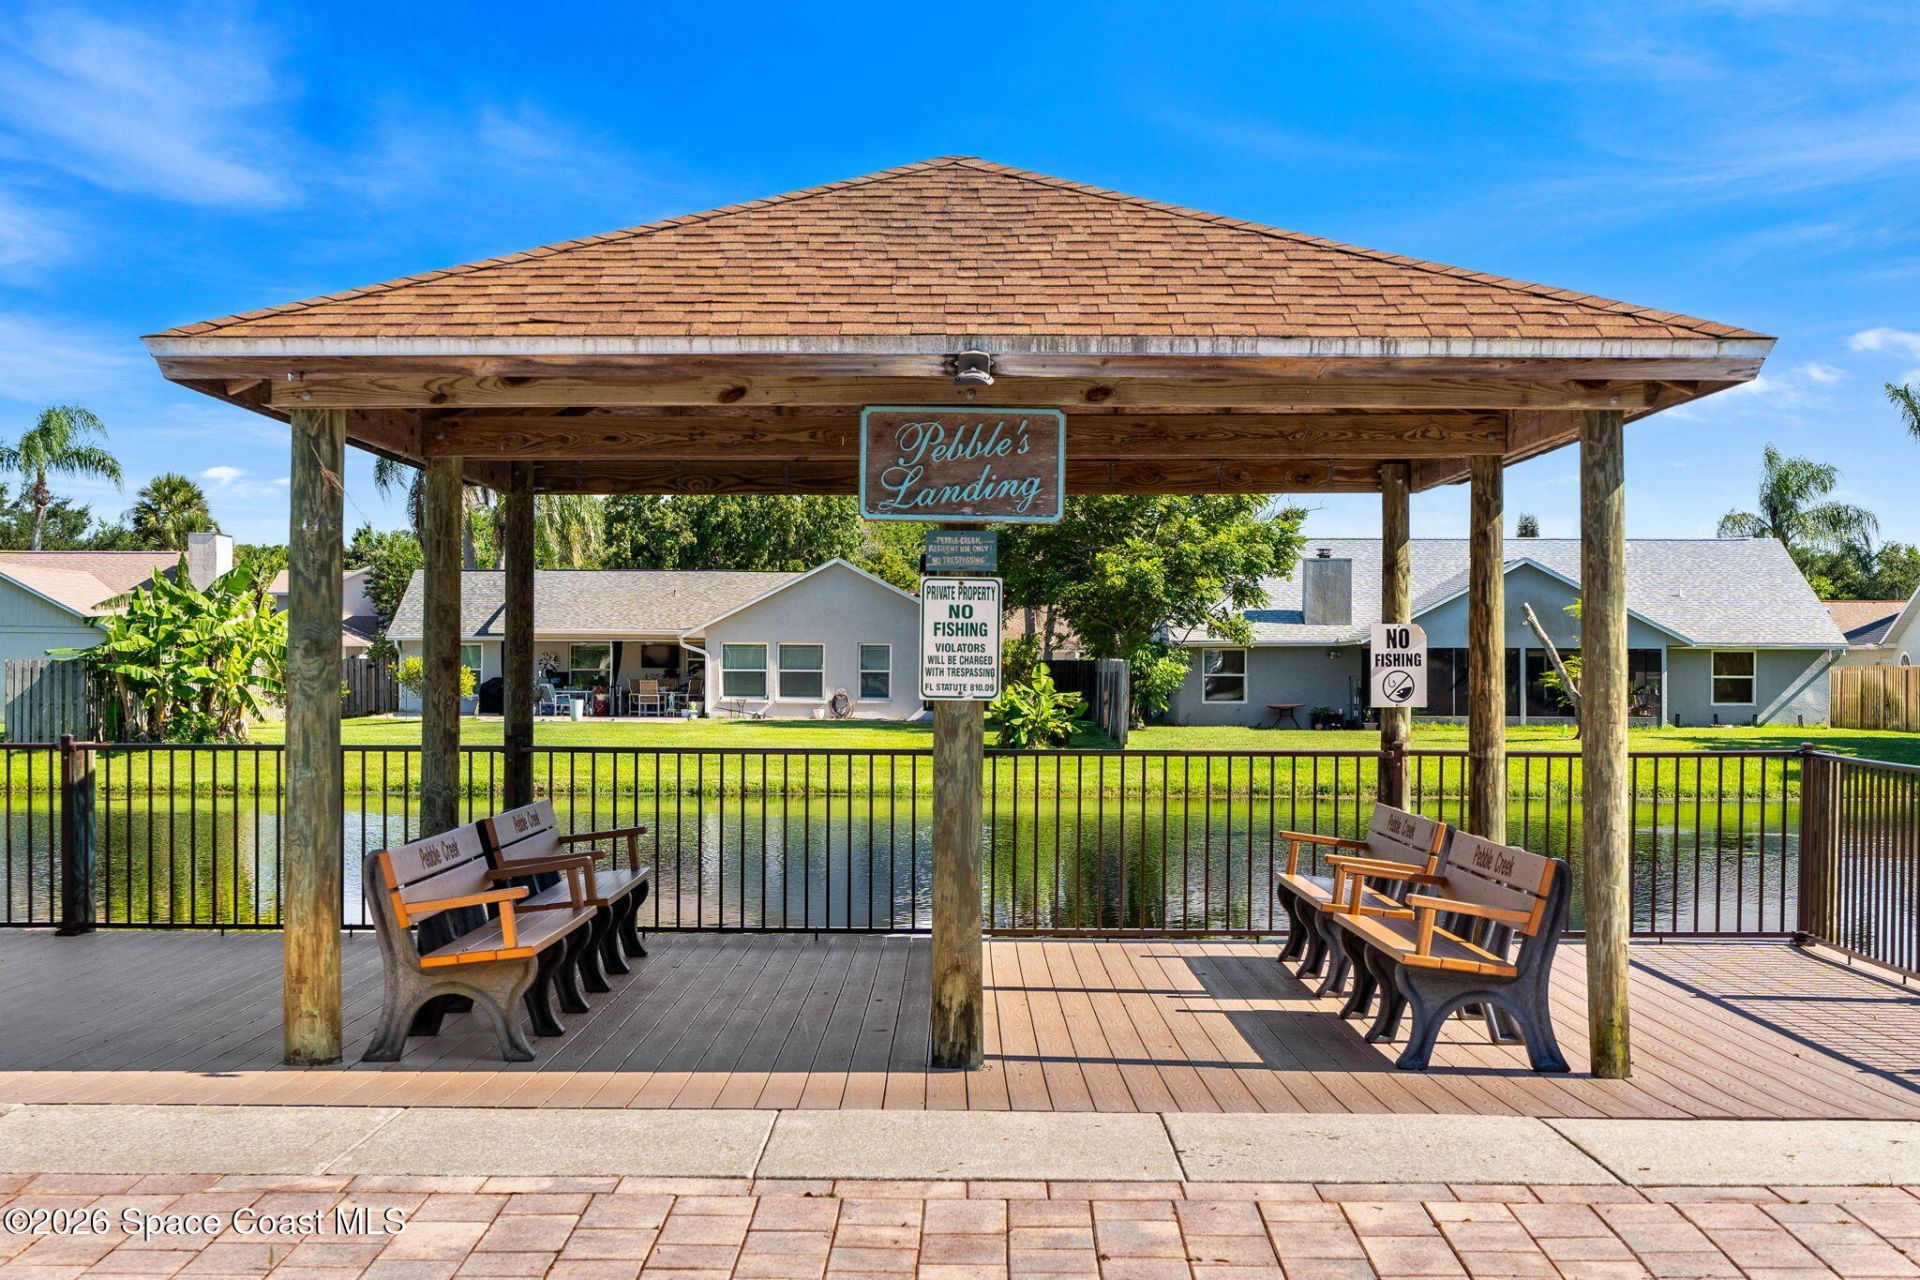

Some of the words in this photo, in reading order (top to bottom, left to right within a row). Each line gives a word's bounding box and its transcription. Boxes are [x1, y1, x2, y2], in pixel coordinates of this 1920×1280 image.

[894, 419, 1031, 467] Pebble's
[878, 464, 1045, 514] Landing
[932, 557, 942, 565] NO
[926, 586, 955, 600] PRIVATE
[958, 586, 996, 601] PROPERTY
[948, 604, 974, 619] NO
[933, 622, 988, 637] FISHING
[1386, 628, 1410, 649] NO
[935, 643, 986, 653] VIOLATORS
[927, 655, 946, 665] WILL
[947, 655, 957, 665] BE
[959, 655, 993, 665] CHARGED
[1375, 653, 1422, 667] FISHING
[925, 667, 945, 677] WITH
[946, 667, 995, 678] TRESPASSING
[924, 683, 934, 691] FL
[936, 683, 968, 692] STATUTE
[969, 683, 995, 692] 810.09
[512, 813, 529, 834] Pebble
[526, 809, 541, 828] Creek
[1387, 813, 1402, 834] Pebble
[1401, 818, 1416, 839] Creek
[418, 843, 442, 869] Pebble
[440, 837, 461, 861] Creek
[1473, 844, 1494, 870] Pebble
[1494, 851, 1515, 877] Creek
